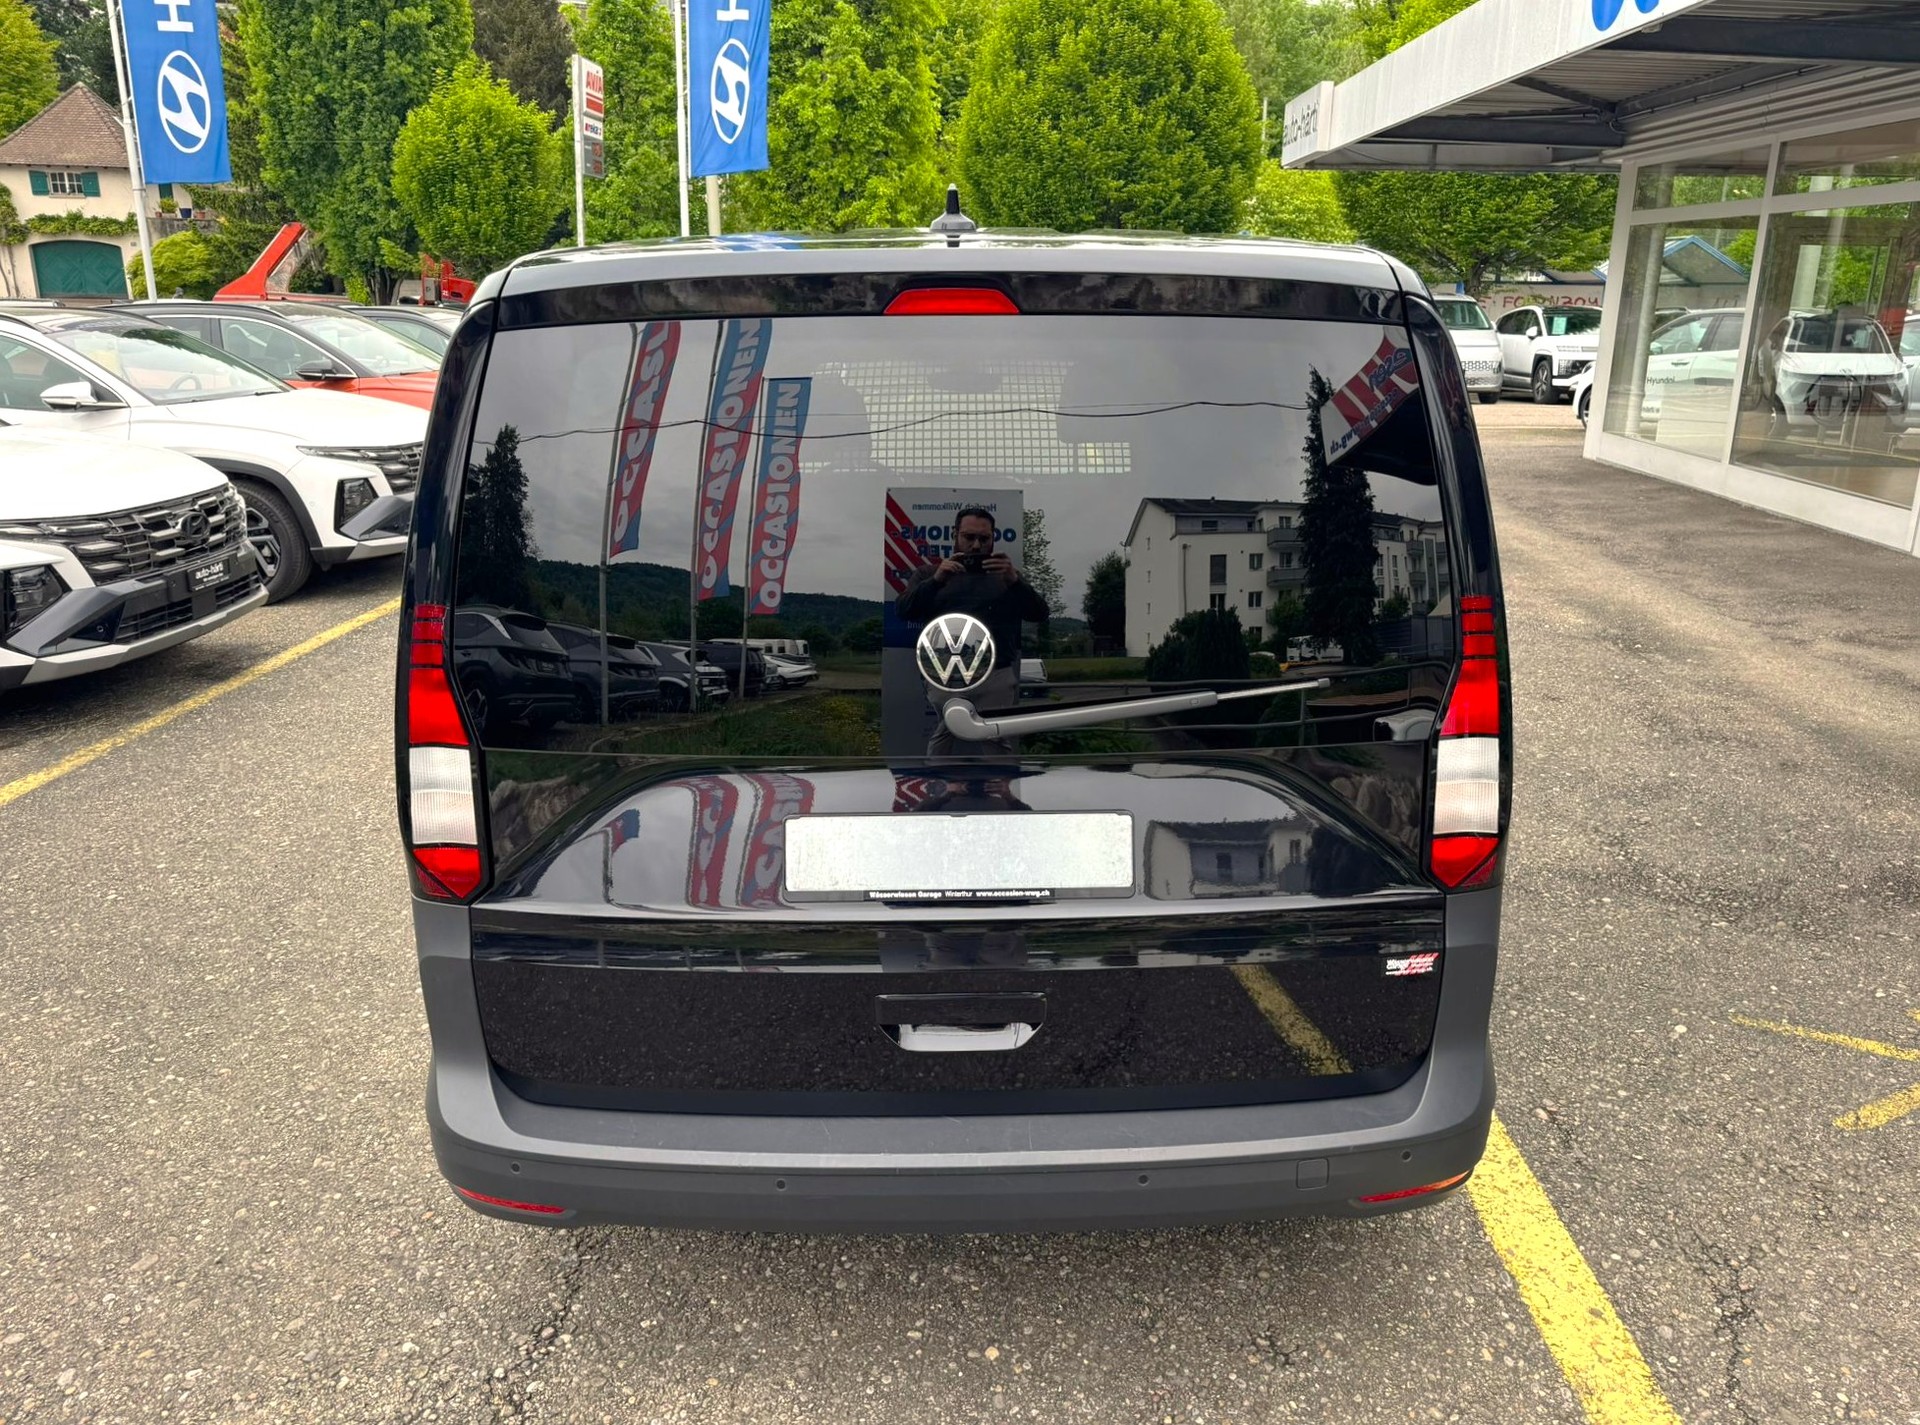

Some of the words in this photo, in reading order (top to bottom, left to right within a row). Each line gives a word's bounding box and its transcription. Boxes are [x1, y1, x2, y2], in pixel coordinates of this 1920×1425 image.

[585, 70, 603, 95] AVIA
[701, 318, 762, 590] OCCASIONEN
[759, 382, 802, 608] OCCASIONEN
[916, 612, 996, 692] VW
[917, 890, 942, 899] Garage
